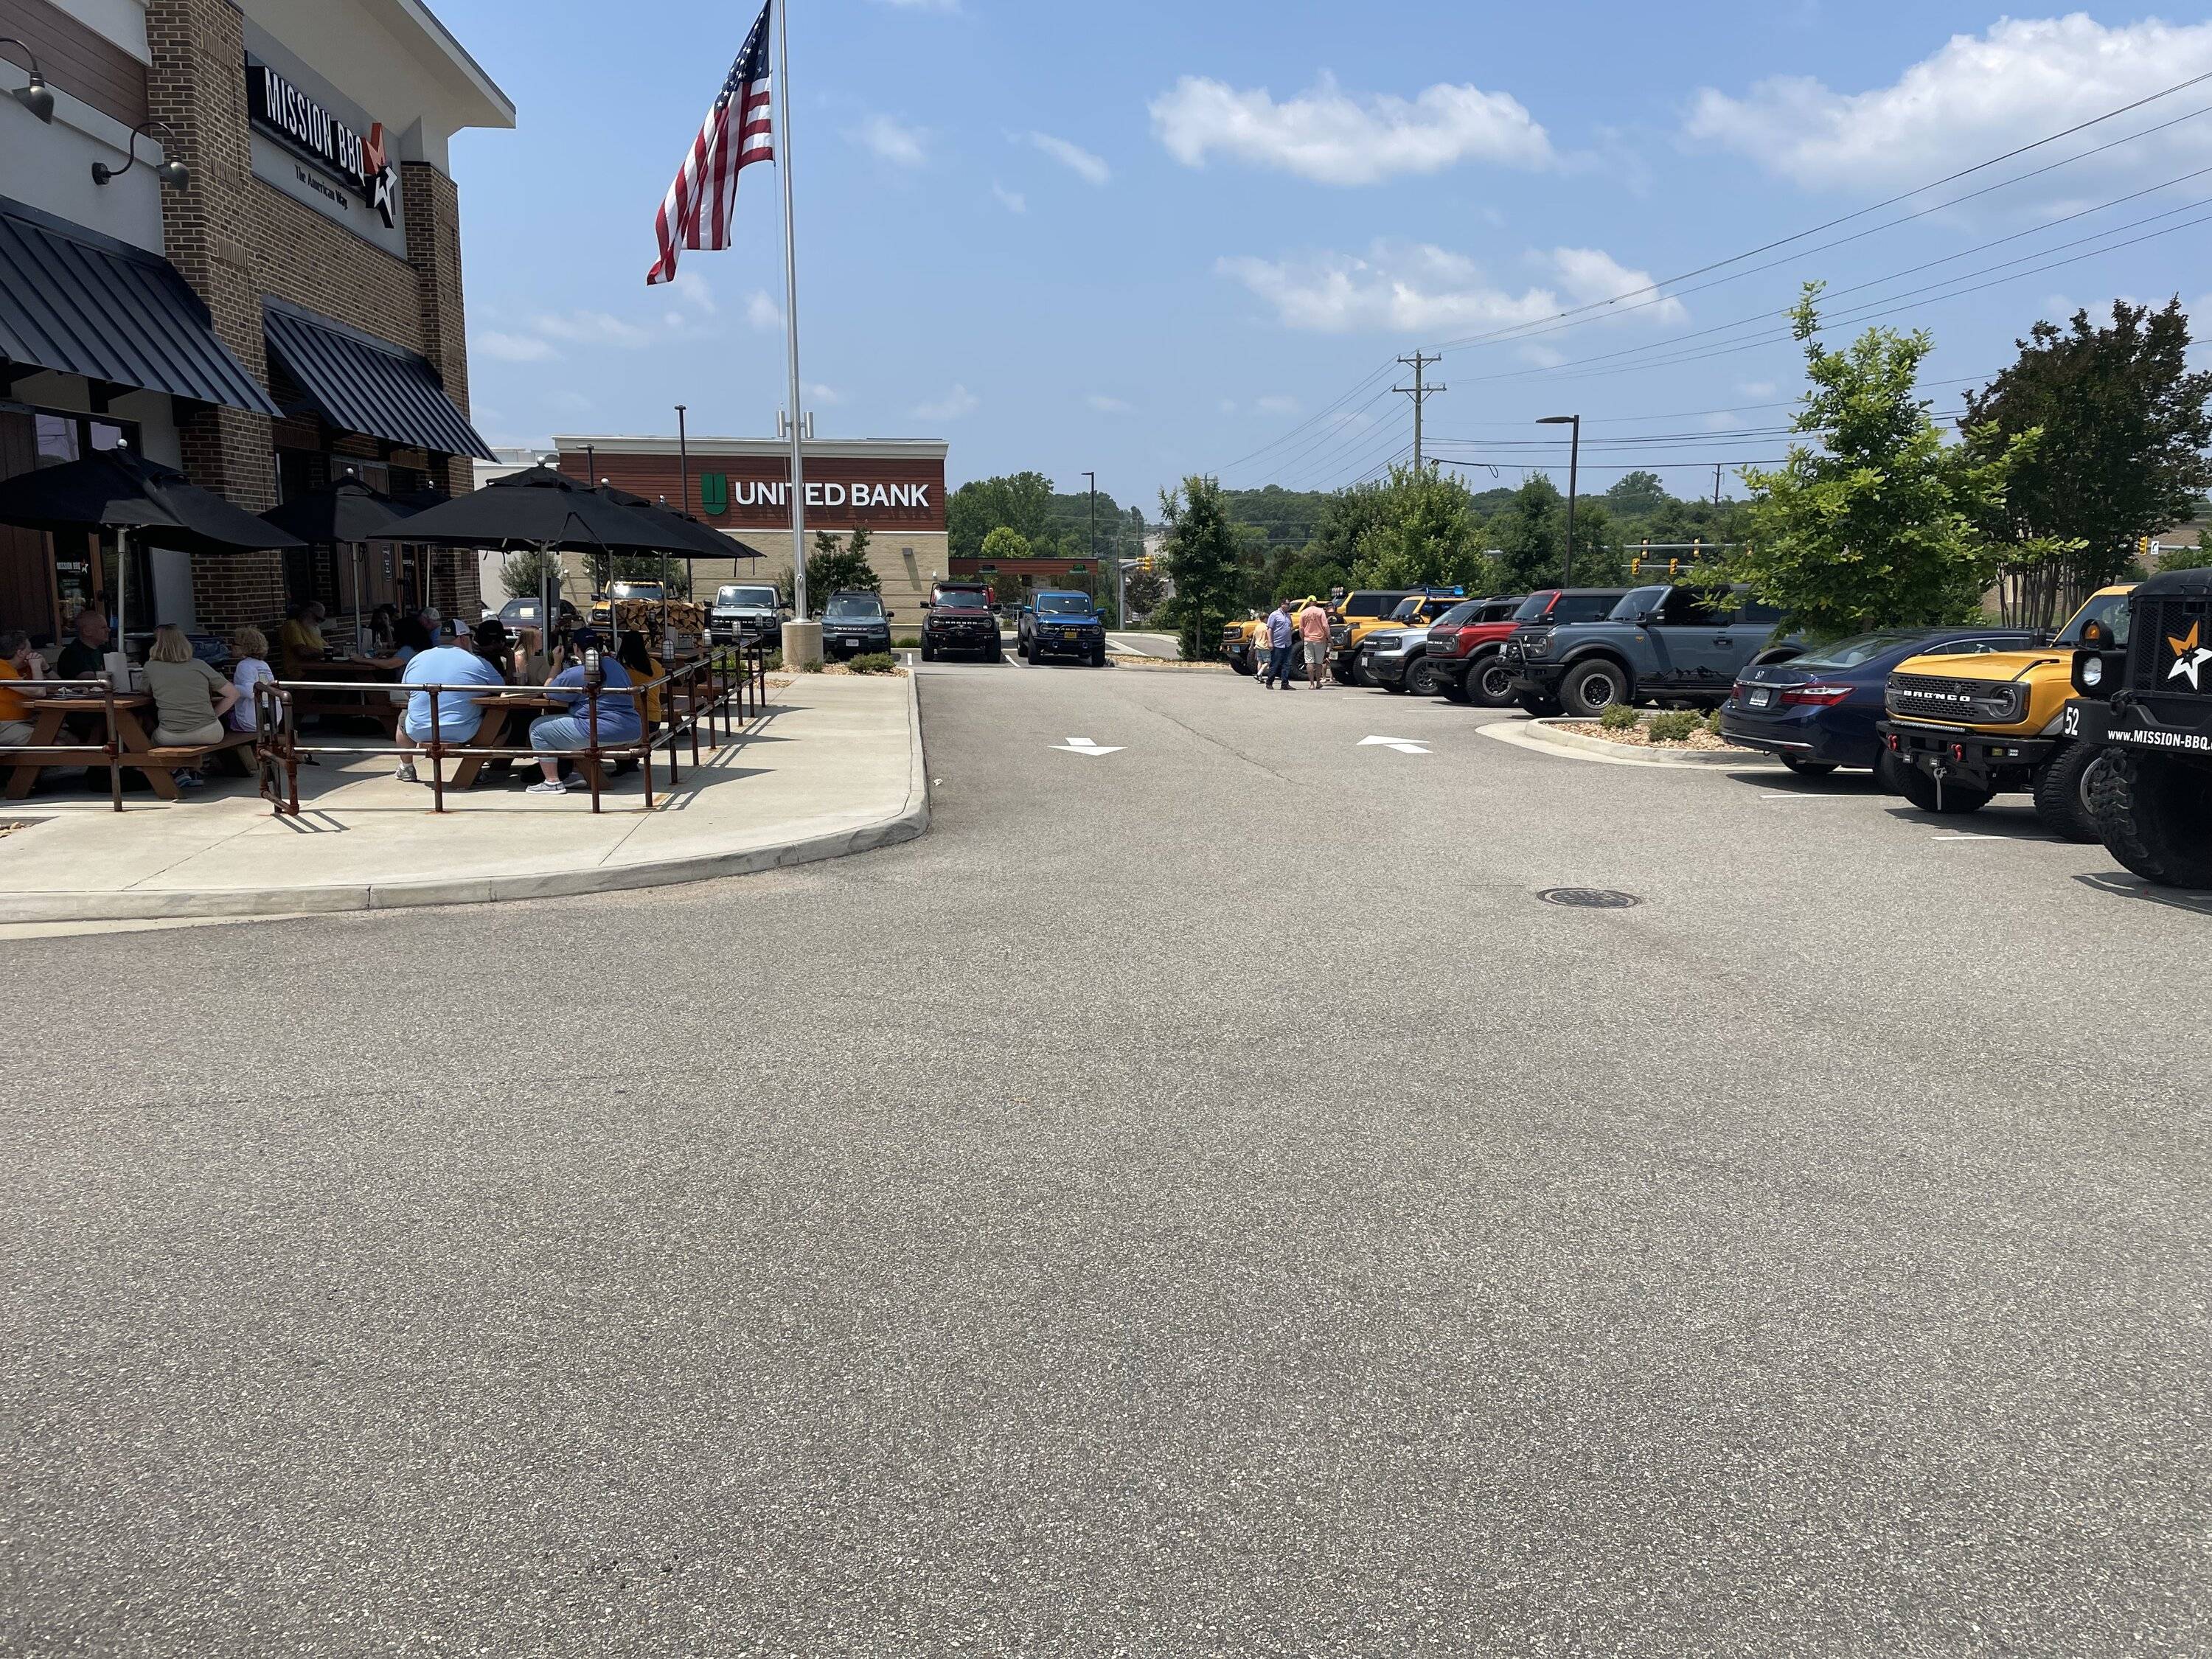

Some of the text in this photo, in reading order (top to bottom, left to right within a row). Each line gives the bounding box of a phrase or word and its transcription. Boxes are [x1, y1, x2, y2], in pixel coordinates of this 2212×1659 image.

[265, 66, 366, 187] MISSION BBQ
[295, 164, 306, 184] The
[307, 173, 335, 201] American
[851, 483, 929, 507] BANK
[1903, 690, 1971, 702] BRONCO
[2065, 706, 2079, 736] 52
[2107, 730, 2212, 751] www.MISSION-BBQ.
